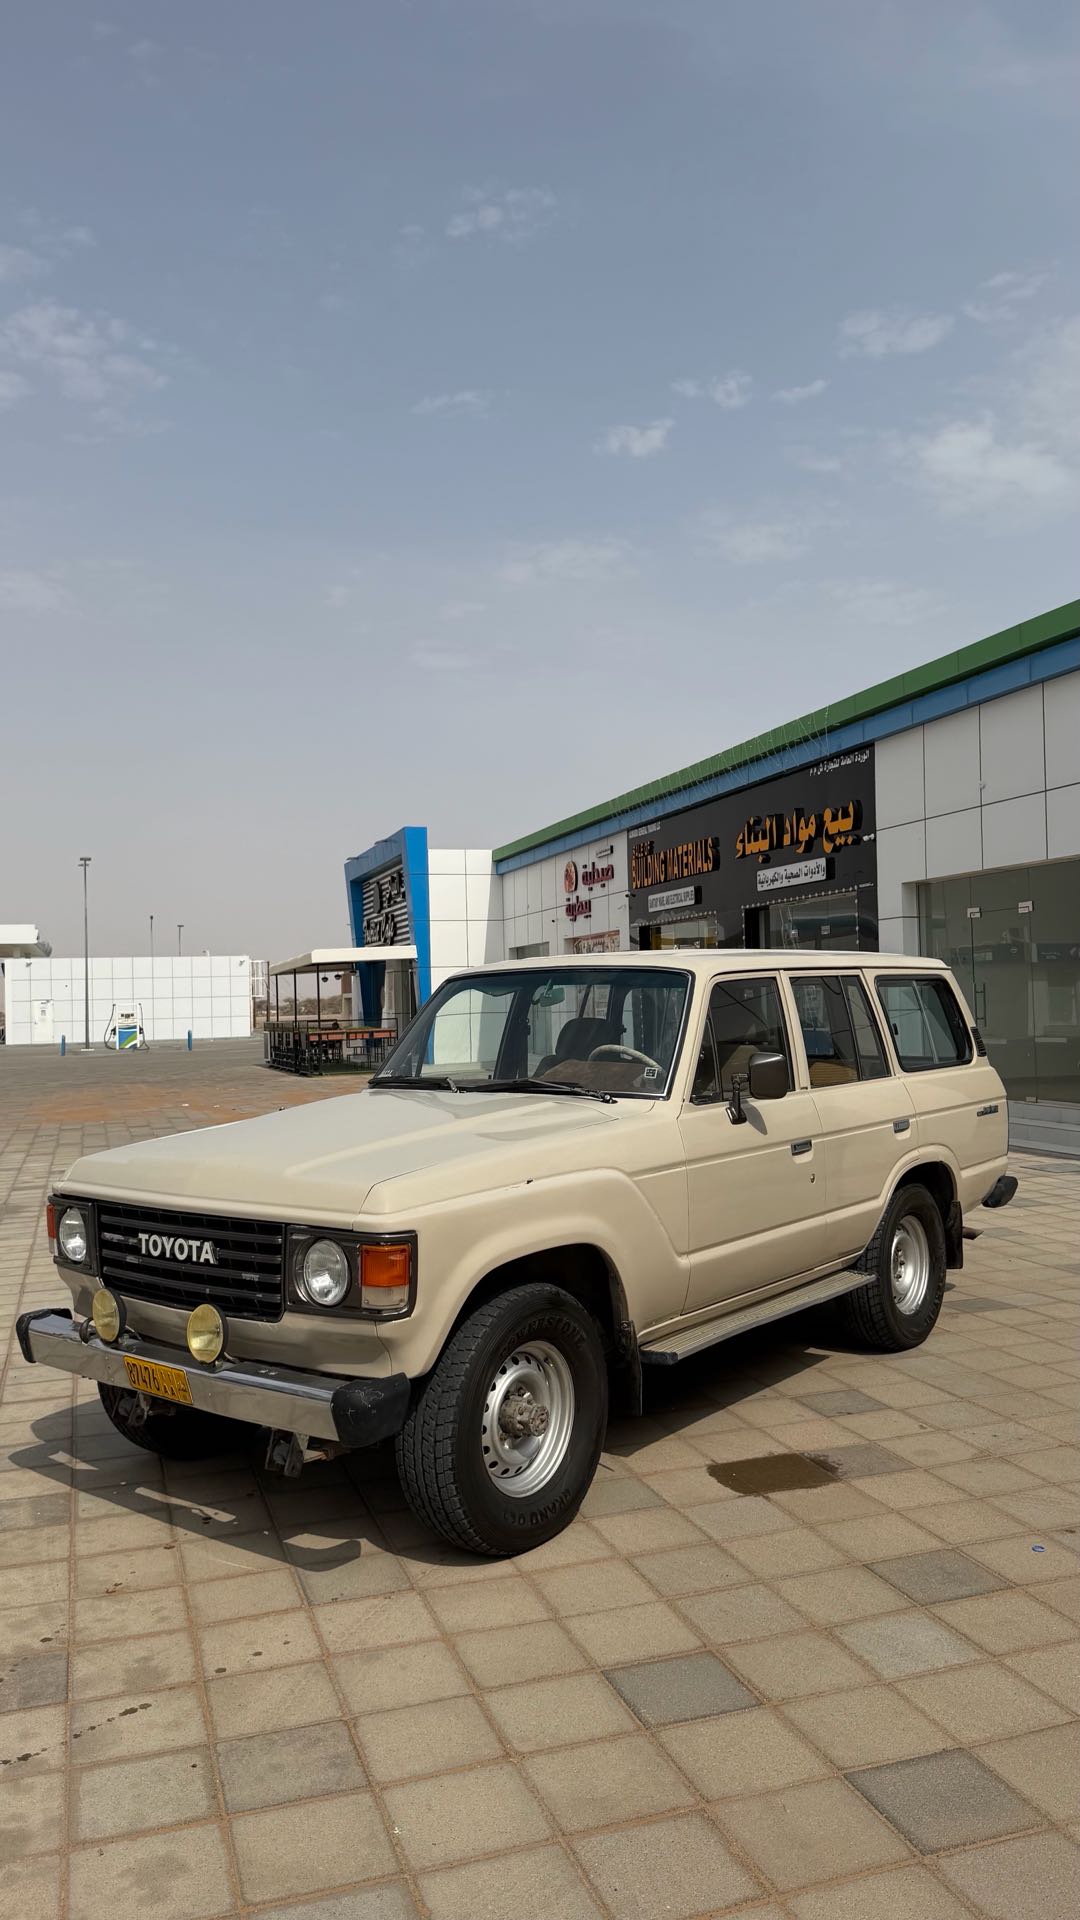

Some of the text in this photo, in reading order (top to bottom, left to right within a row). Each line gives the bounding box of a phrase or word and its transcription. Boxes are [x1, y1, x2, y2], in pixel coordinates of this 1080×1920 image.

[735, 800, 854, 863] بيع مواد البناء
[581, 862, 615, 892] صيدلية
[632, 836, 713, 889] BUILDING MATERIALS
[784, 867, 803, 884] الصحية
[803, 861, 826, 881] والأدوات
[565, 895, 592, 922] بيطرية
[138, 1233, 217, 1264] TOYOTA
[126, 1361, 161, 1392] 87476
